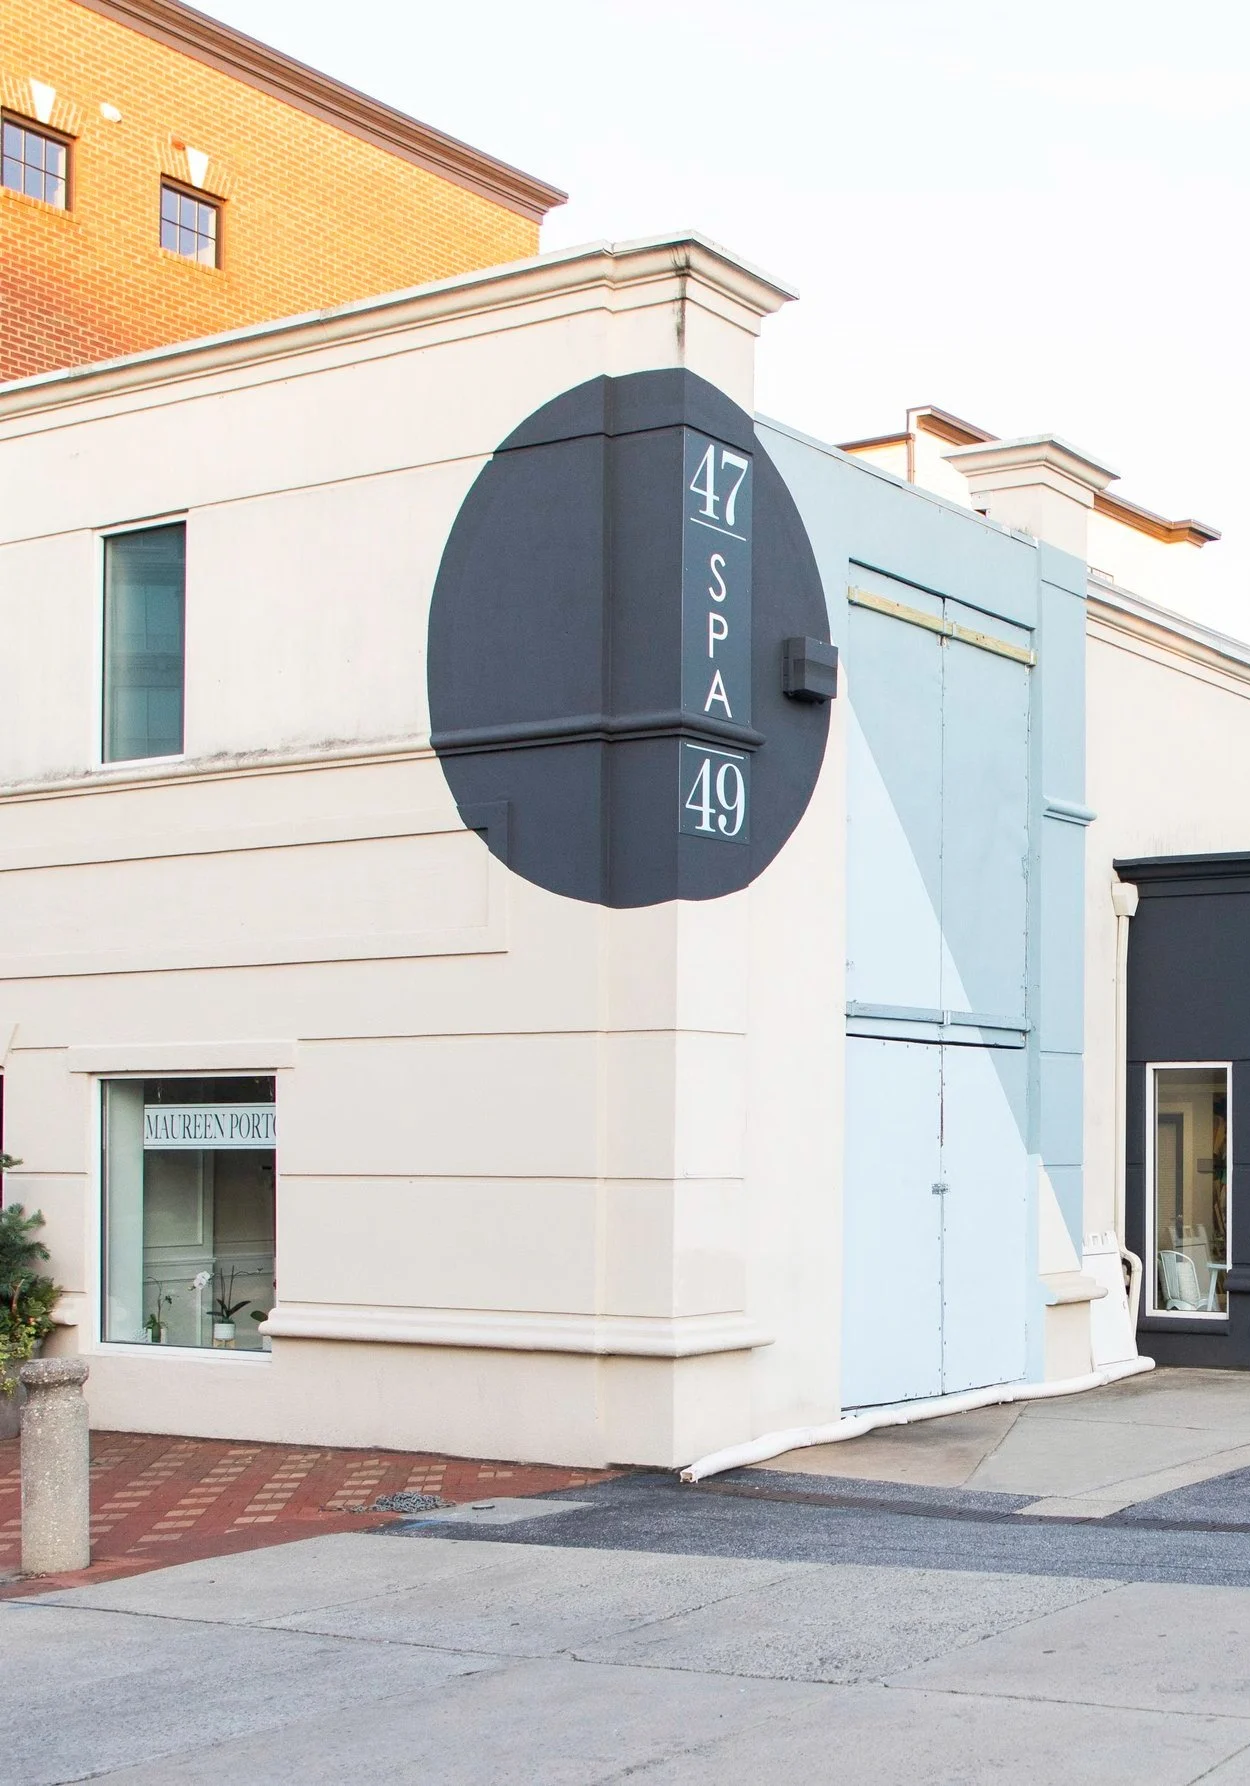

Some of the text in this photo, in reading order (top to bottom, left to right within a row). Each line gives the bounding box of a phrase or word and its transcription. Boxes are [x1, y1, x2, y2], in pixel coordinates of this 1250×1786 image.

[690, 444, 749, 527] 47
[704, 553, 733, 719] SPA
[685, 758, 746, 837] 49
[145, 1113, 225, 1140] MAUREEN
